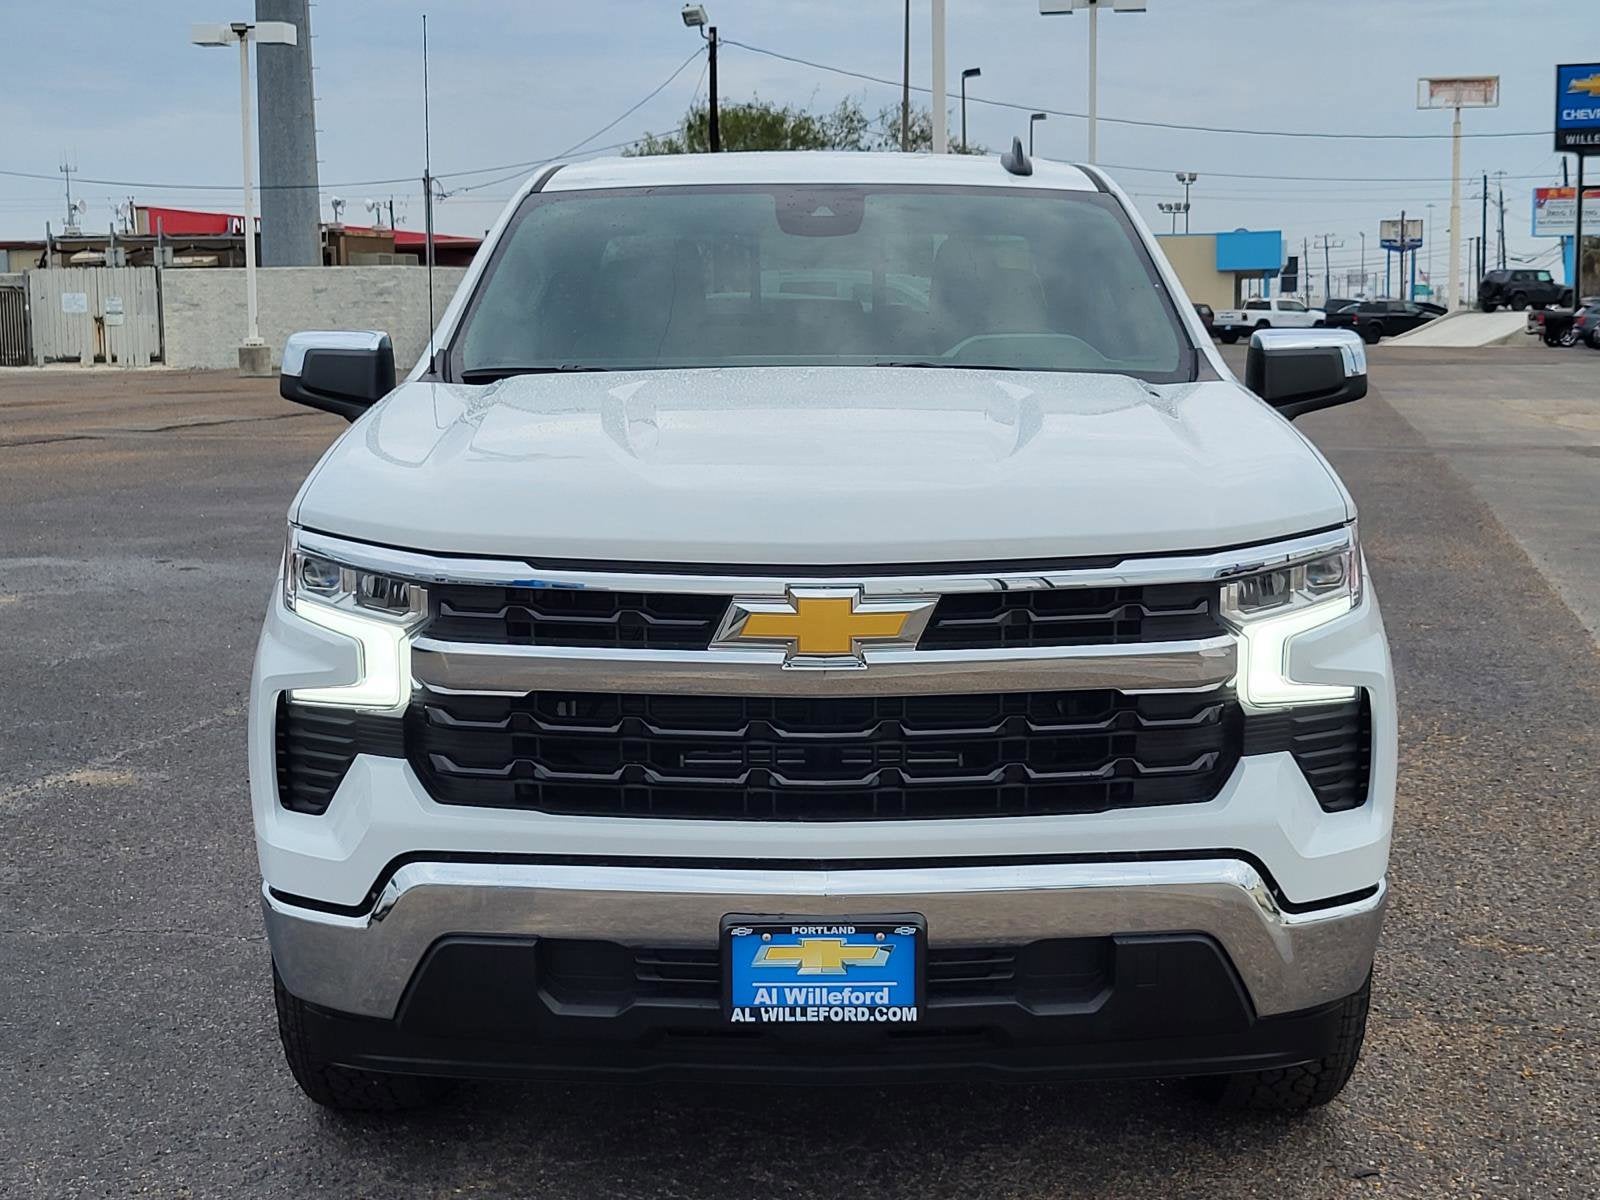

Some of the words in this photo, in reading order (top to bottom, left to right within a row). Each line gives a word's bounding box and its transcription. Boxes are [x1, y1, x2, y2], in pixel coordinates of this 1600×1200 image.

[1566, 134, 1600, 145] WILLE
[791, 926, 856, 935] PORTLAND
[754, 987, 778, 1005] Al
[784, 986, 889, 1005] Willeford
[731, 1007, 756, 1022] AL
[761, 1006, 917, 1022] WILLEFORD.COM
